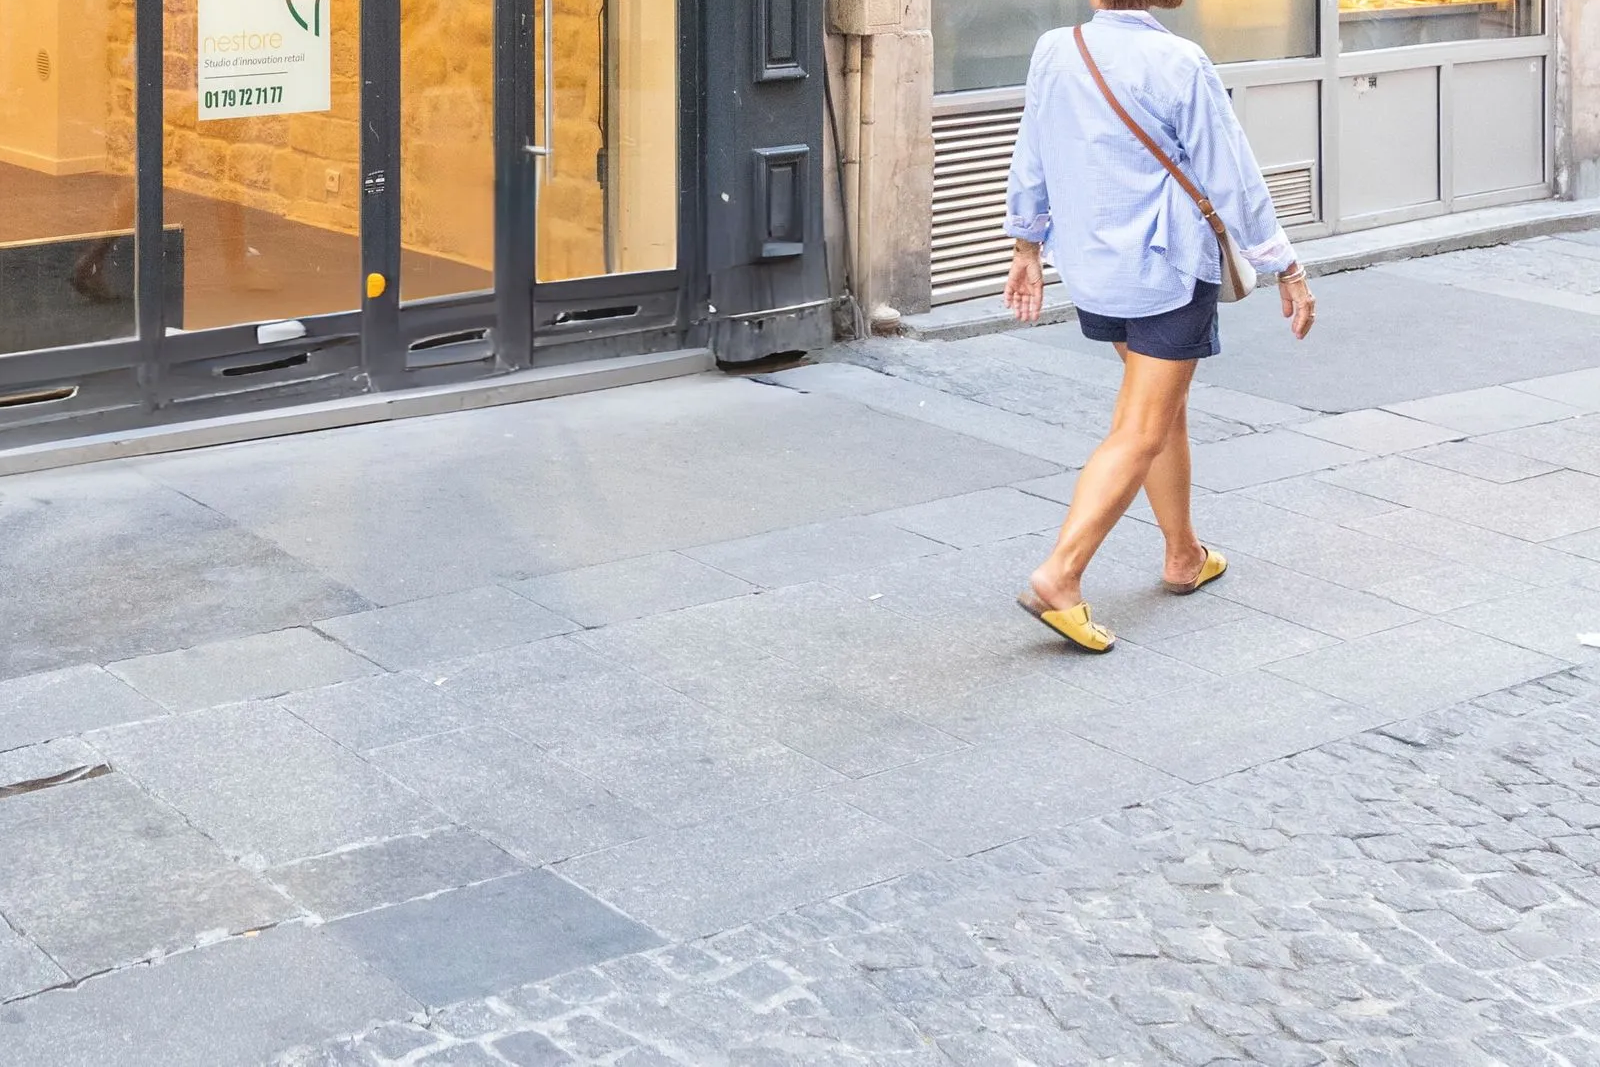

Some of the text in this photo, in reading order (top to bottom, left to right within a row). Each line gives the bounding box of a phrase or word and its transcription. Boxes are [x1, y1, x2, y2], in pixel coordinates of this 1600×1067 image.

[203, 29, 283, 53] nestore
[204, 53, 305, 68] Studio d'innovation retail
[204, 86, 283, 108] 01 79 72 71 77
